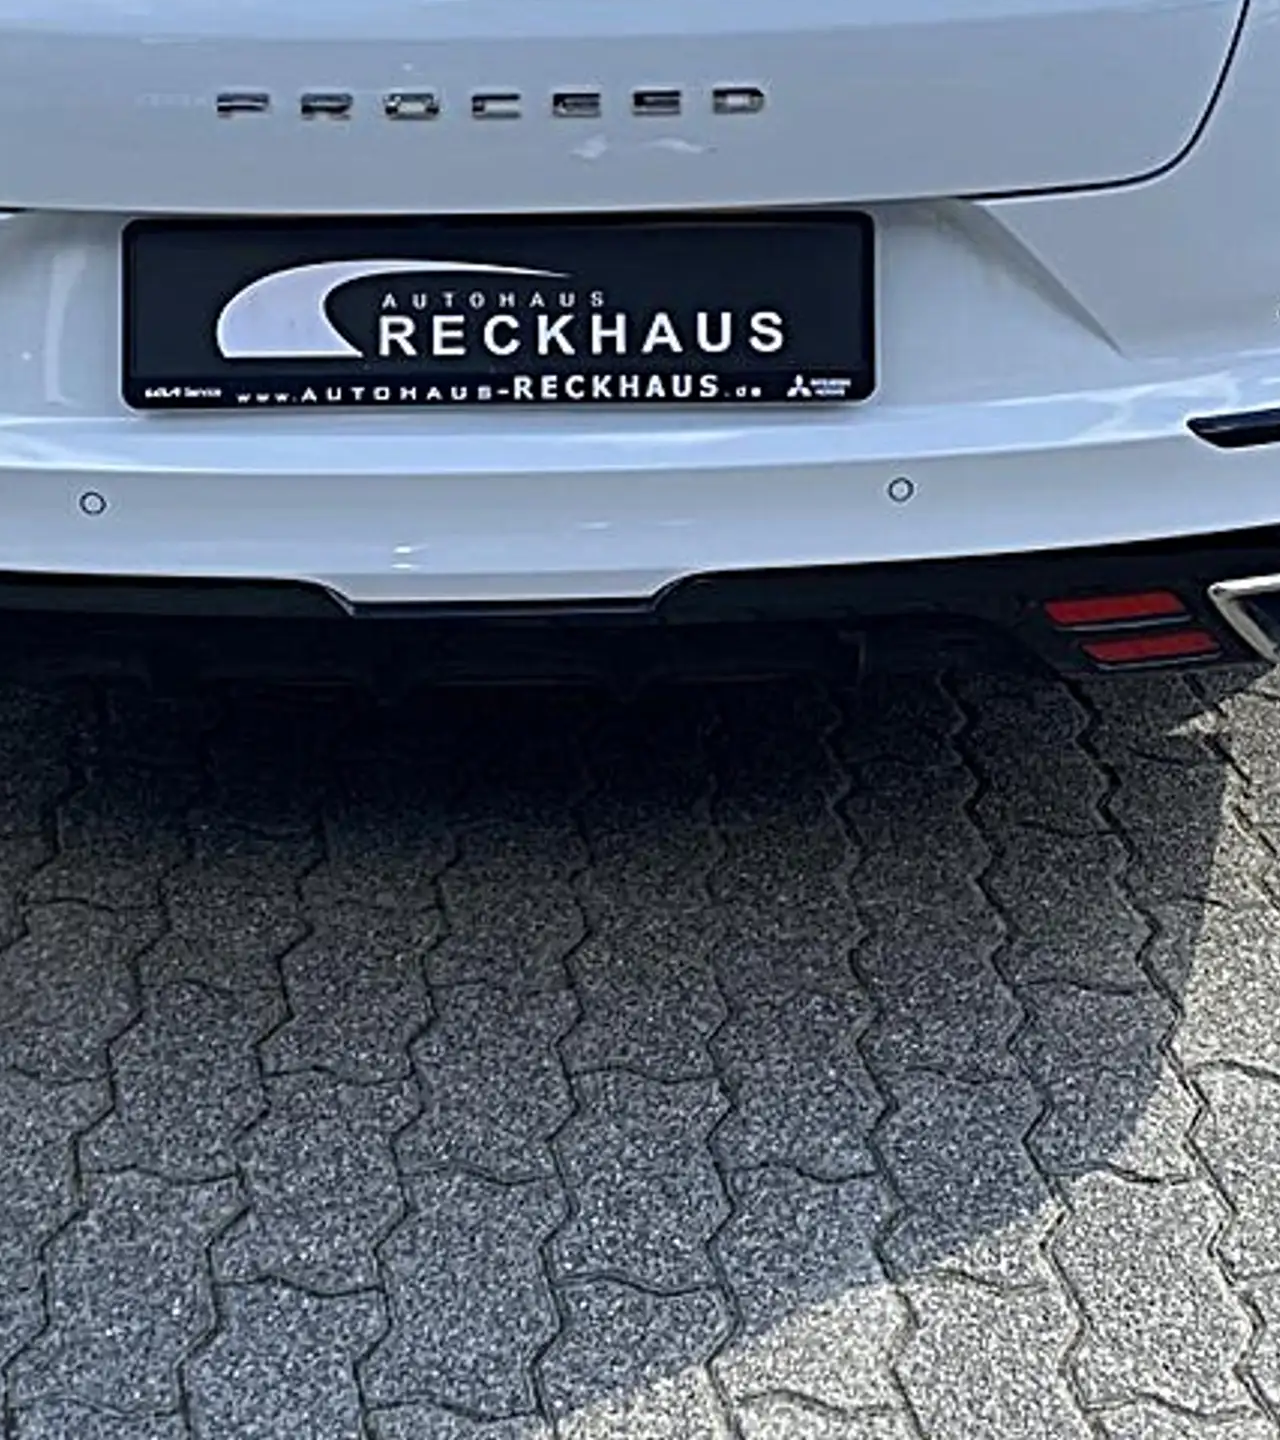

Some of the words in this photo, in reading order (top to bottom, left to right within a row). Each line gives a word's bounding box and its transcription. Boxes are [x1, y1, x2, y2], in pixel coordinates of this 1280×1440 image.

[217, 88, 766, 120] PROCEED
[382, 291, 605, 309] AUTOHAUS
[379, 312, 783, 356] RECKHAUS
